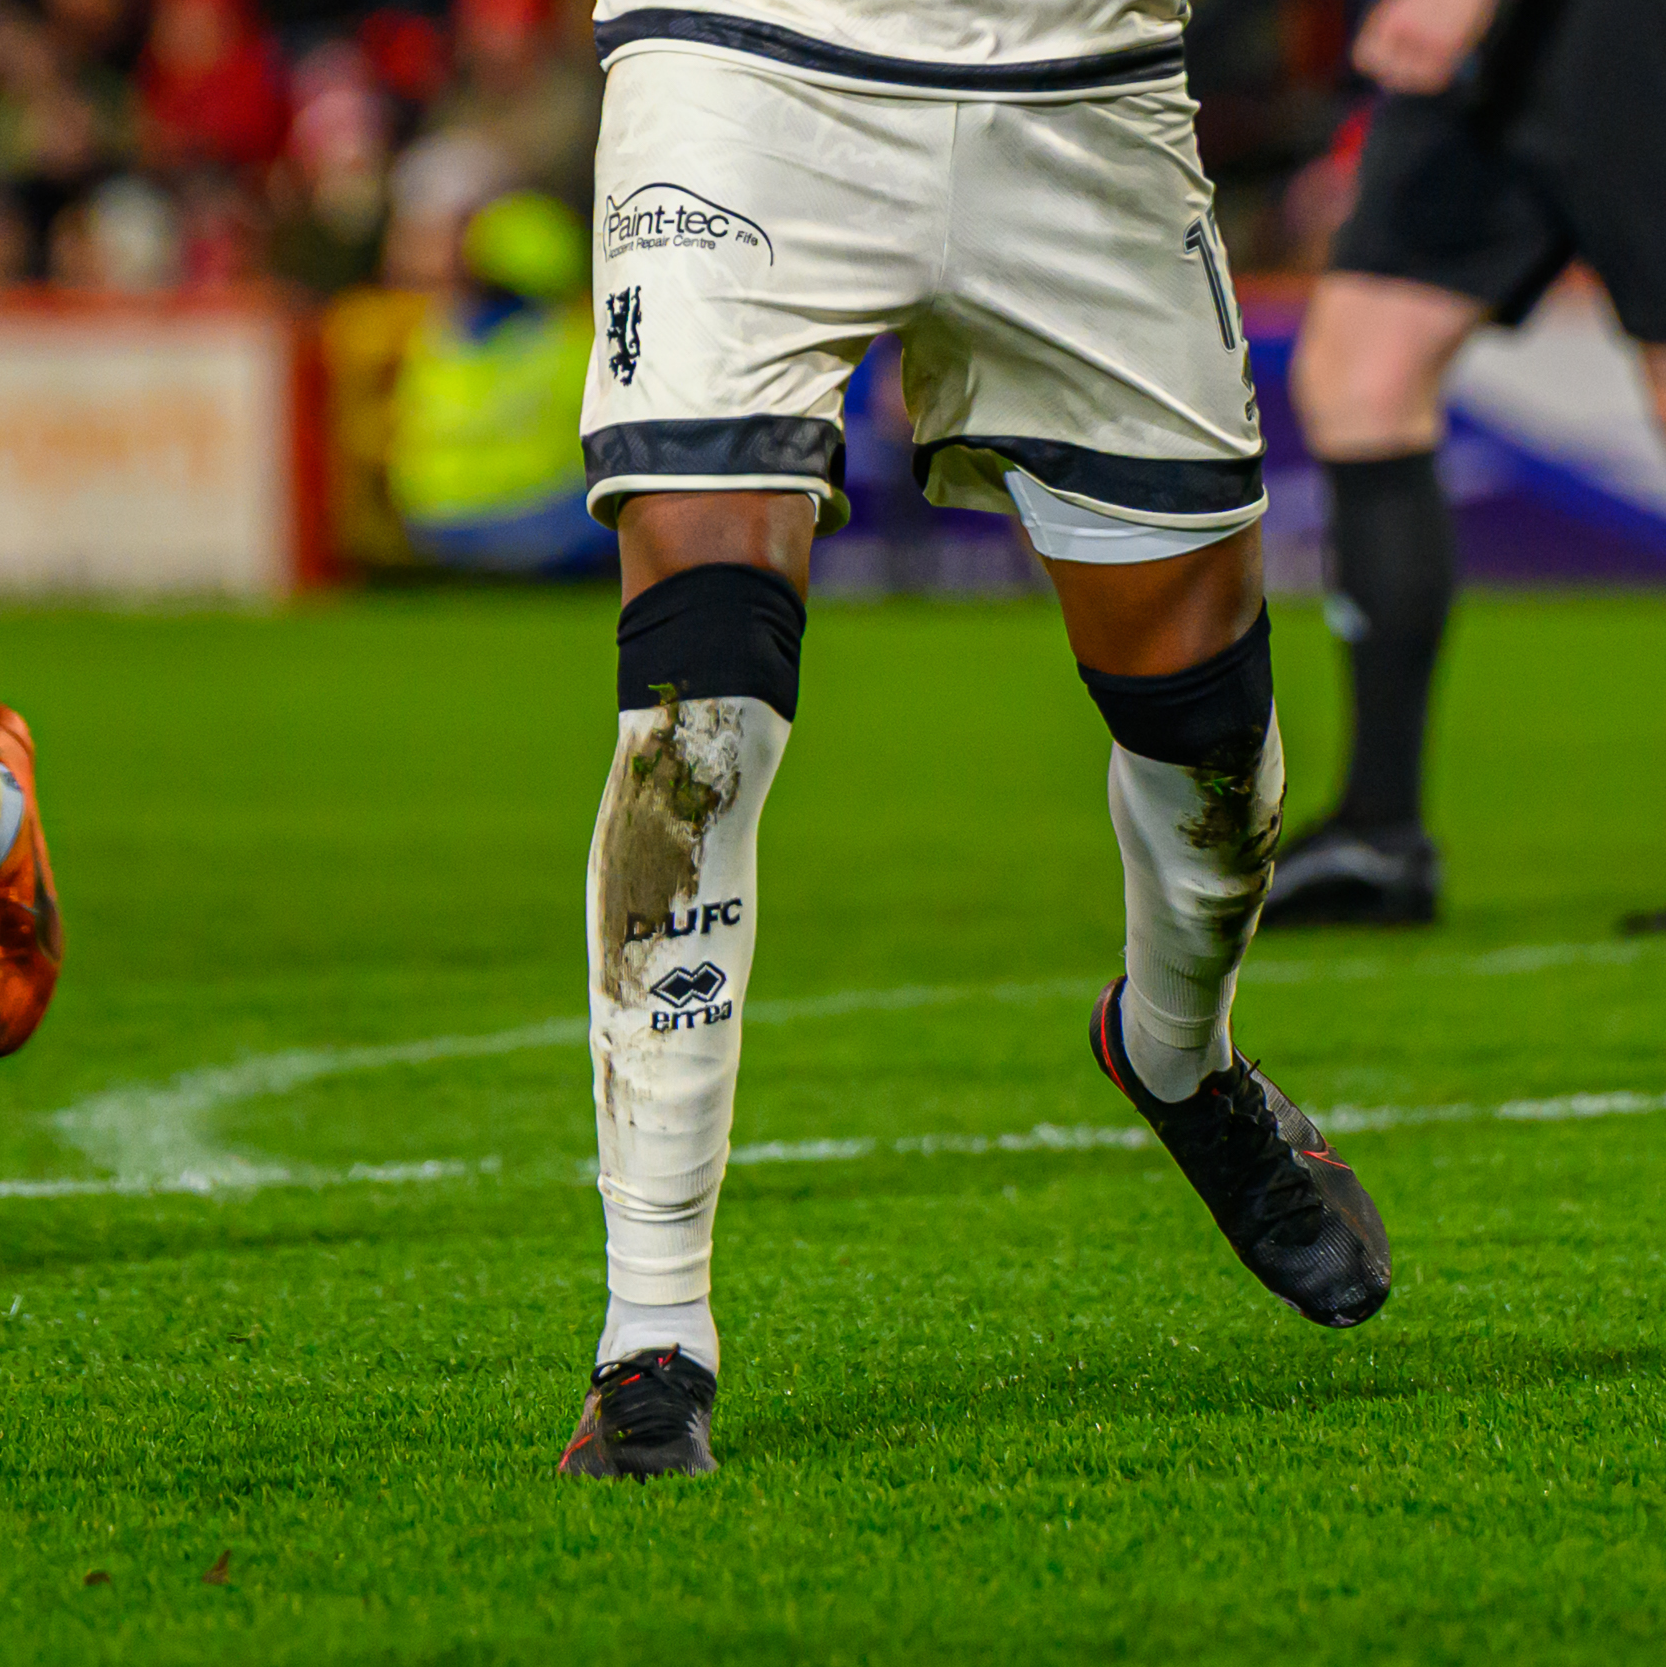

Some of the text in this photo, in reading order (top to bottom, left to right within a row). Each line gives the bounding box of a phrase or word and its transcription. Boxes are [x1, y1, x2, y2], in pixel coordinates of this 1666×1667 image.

[608, 205, 730, 246] Paint-tec
[735, 230, 759, 246] Fife
[636, 236, 670, 249] Repair
[673, 234, 716, 250] Centre
[651, 999, 733, 1033] errea
